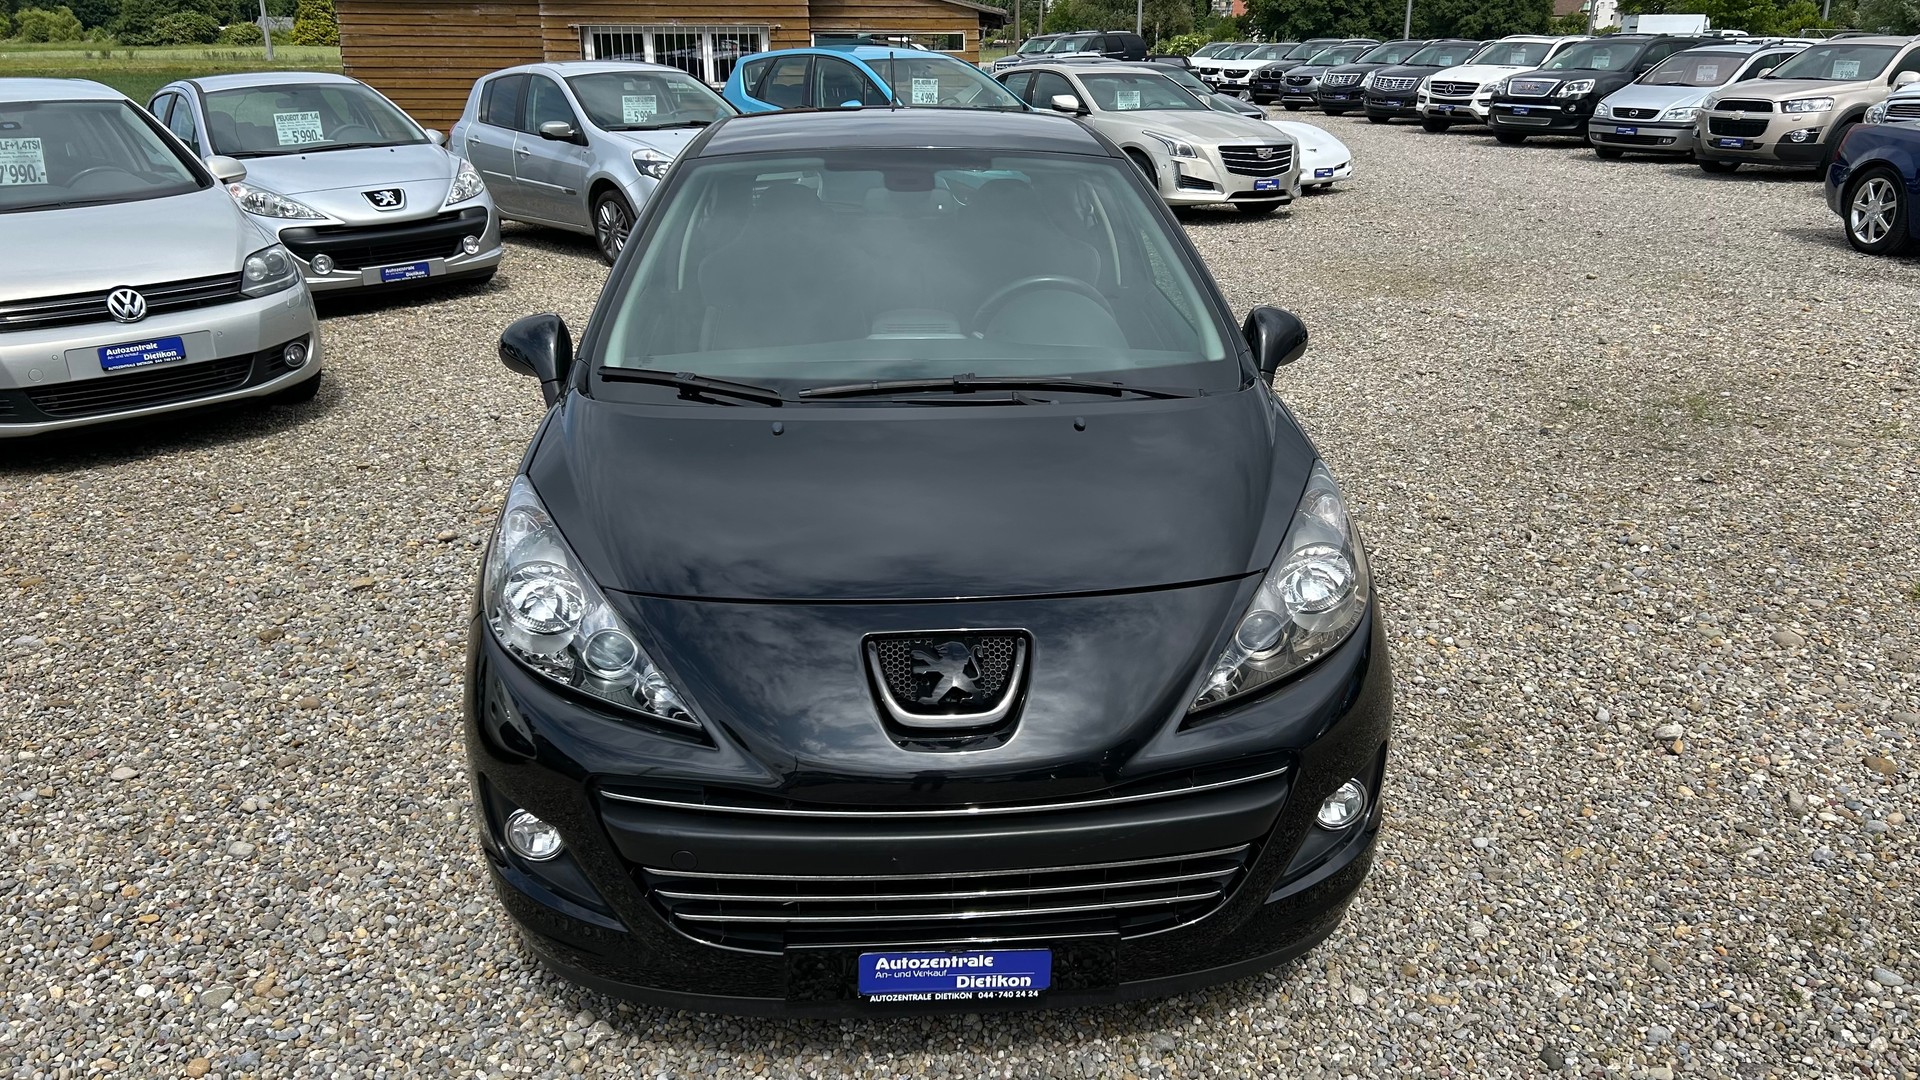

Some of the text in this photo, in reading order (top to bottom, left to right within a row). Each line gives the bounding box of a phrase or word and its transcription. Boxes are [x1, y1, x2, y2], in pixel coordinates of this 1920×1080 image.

[276, 113, 299, 122] PEUGEOT
[106, 342, 158, 356] Autozentrale
[143, 350, 177, 360] Dietikon
[875, 954, 994, 970] Autozentrale
[875, 969, 948, 979] An- und Verkauf
[956, 974, 1032, 989] Dietikon
[869, 993, 932, 1003] AUTOZENTRALE
[935, 992, 973, 1000] DIETIKON
[1015, 990, 1026, 998] 24
[1028, 990, 1039, 998] 24
